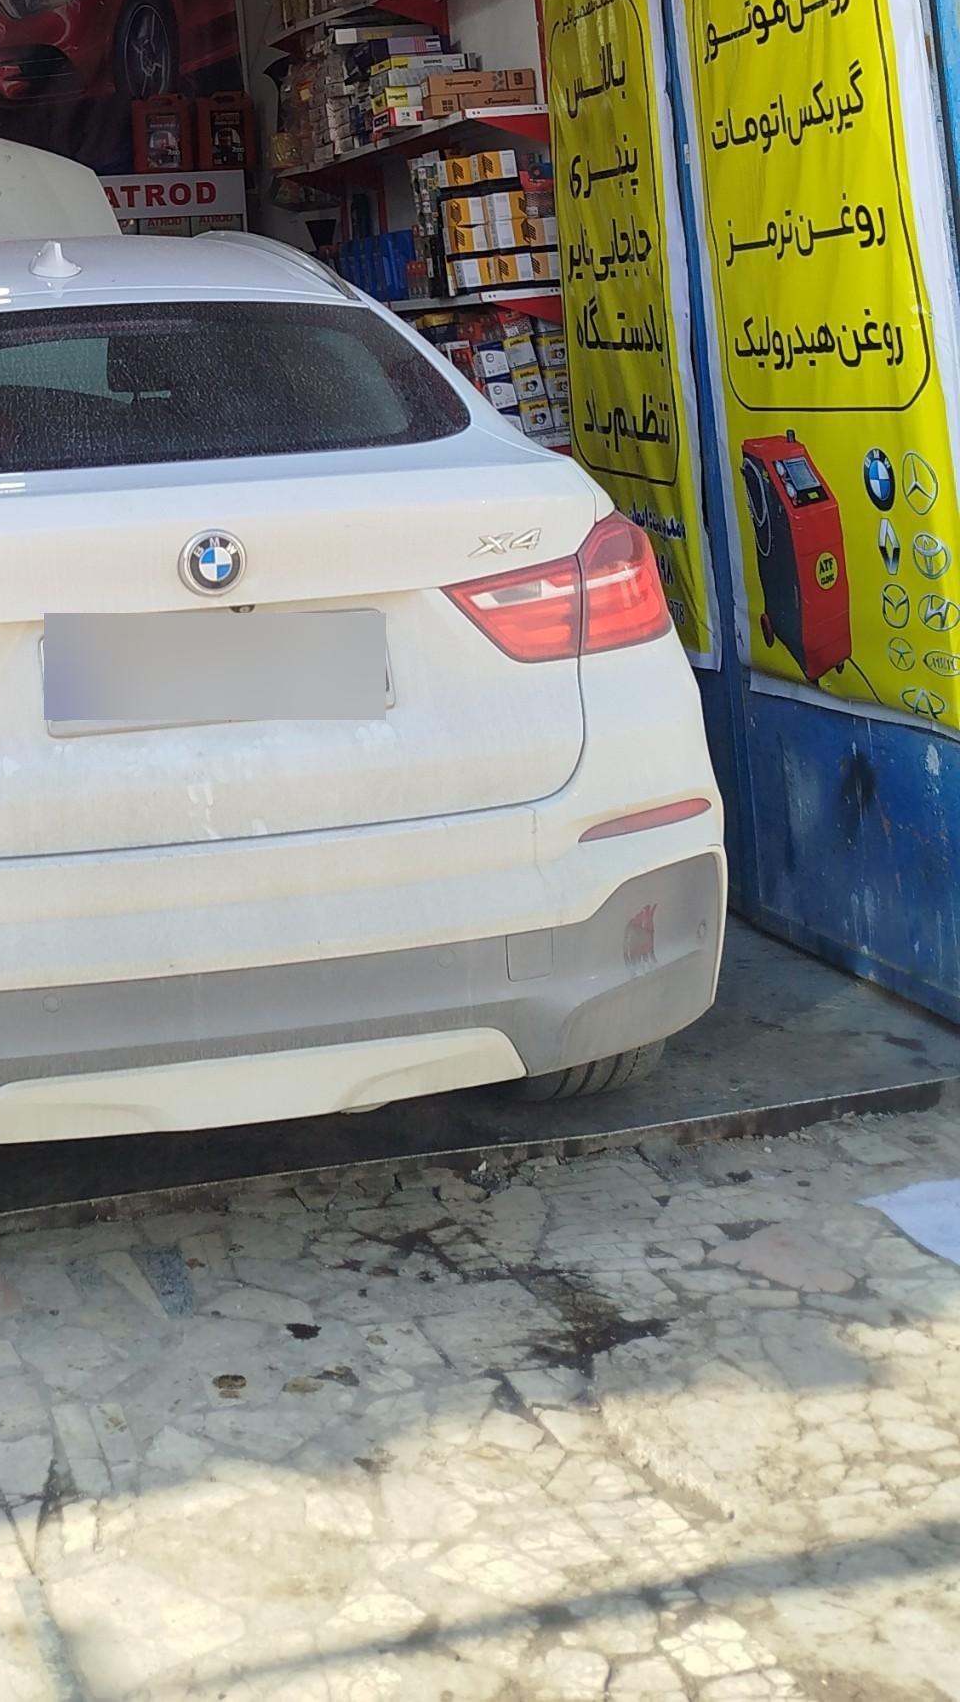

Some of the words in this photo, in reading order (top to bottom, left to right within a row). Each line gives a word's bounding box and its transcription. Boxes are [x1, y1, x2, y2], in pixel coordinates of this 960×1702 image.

[565, 42, 627, 120] بالانس
[786, 58, 865, 148] گیربکس
[710, 97, 789, 154] اتومات
[568, 129, 639, 197] پنچری
[725, 208, 796, 268] ترمز
[794, 191, 887, 259] روغن
[734, 314, 838, 372] هیدرولیک
[834, 307, 905, 369] روغن
[613, 393, 671, 453] تنظیم
[467, 527, 543, 559] X4
[818, 556, 834, 575] ATF
